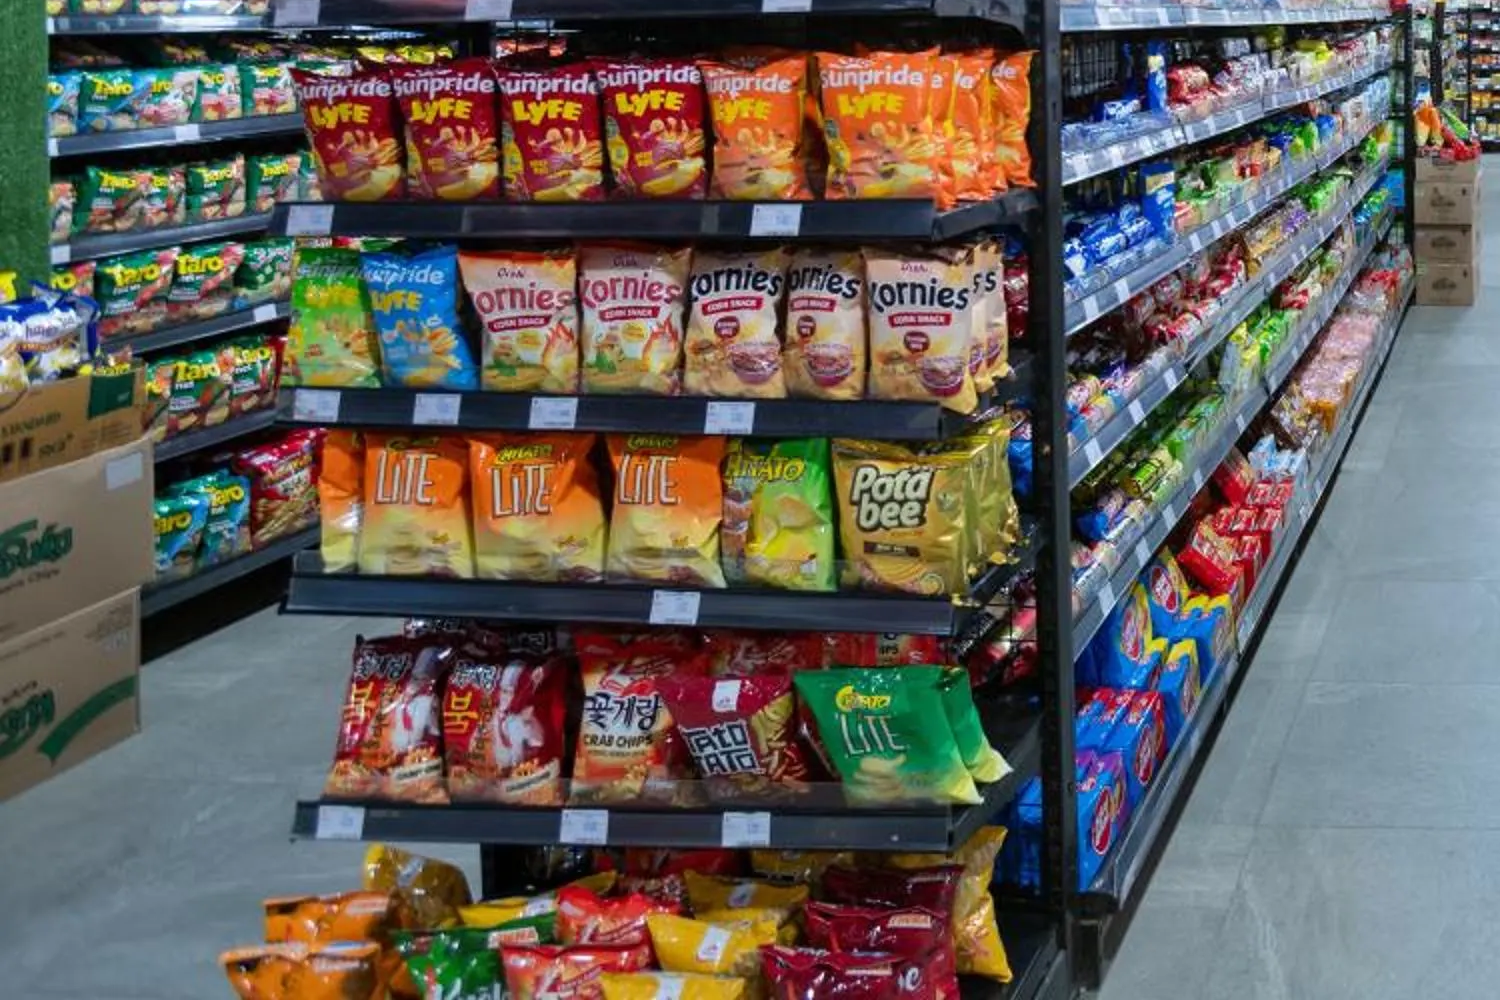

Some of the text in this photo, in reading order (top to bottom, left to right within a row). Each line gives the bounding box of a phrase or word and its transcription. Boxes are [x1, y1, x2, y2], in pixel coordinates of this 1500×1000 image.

[176, 255, 225, 275] Taro
[469, 281, 575, 314] ornies
[850, 465, 934, 503] Pota
[154, 512, 192, 533] aro
[858, 493, 925, 531] bee
